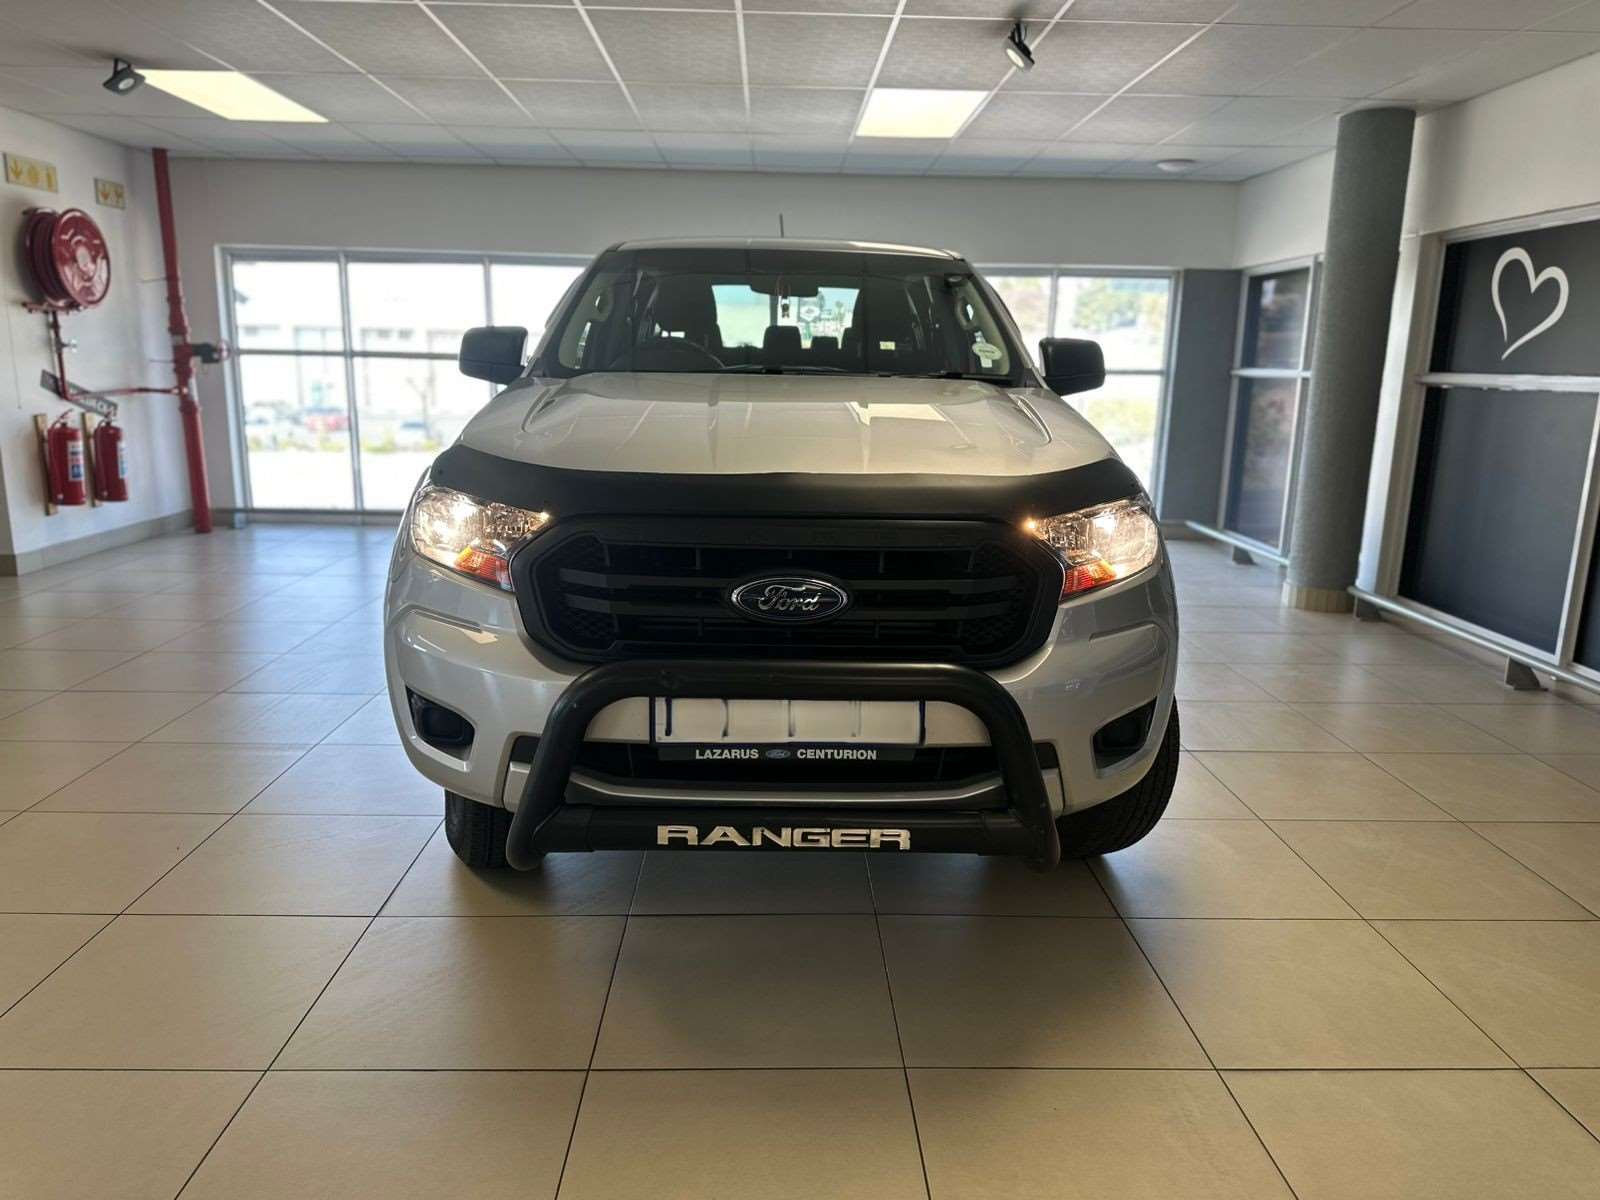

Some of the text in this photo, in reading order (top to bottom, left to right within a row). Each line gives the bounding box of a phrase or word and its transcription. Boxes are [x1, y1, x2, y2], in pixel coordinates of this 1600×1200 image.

[757, 583, 822, 612] Ford
[695, 748, 760, 760] LAZARUS
[796, 748, 878, 761] CENTURION
[656, 824, 912, 851] RANGER
